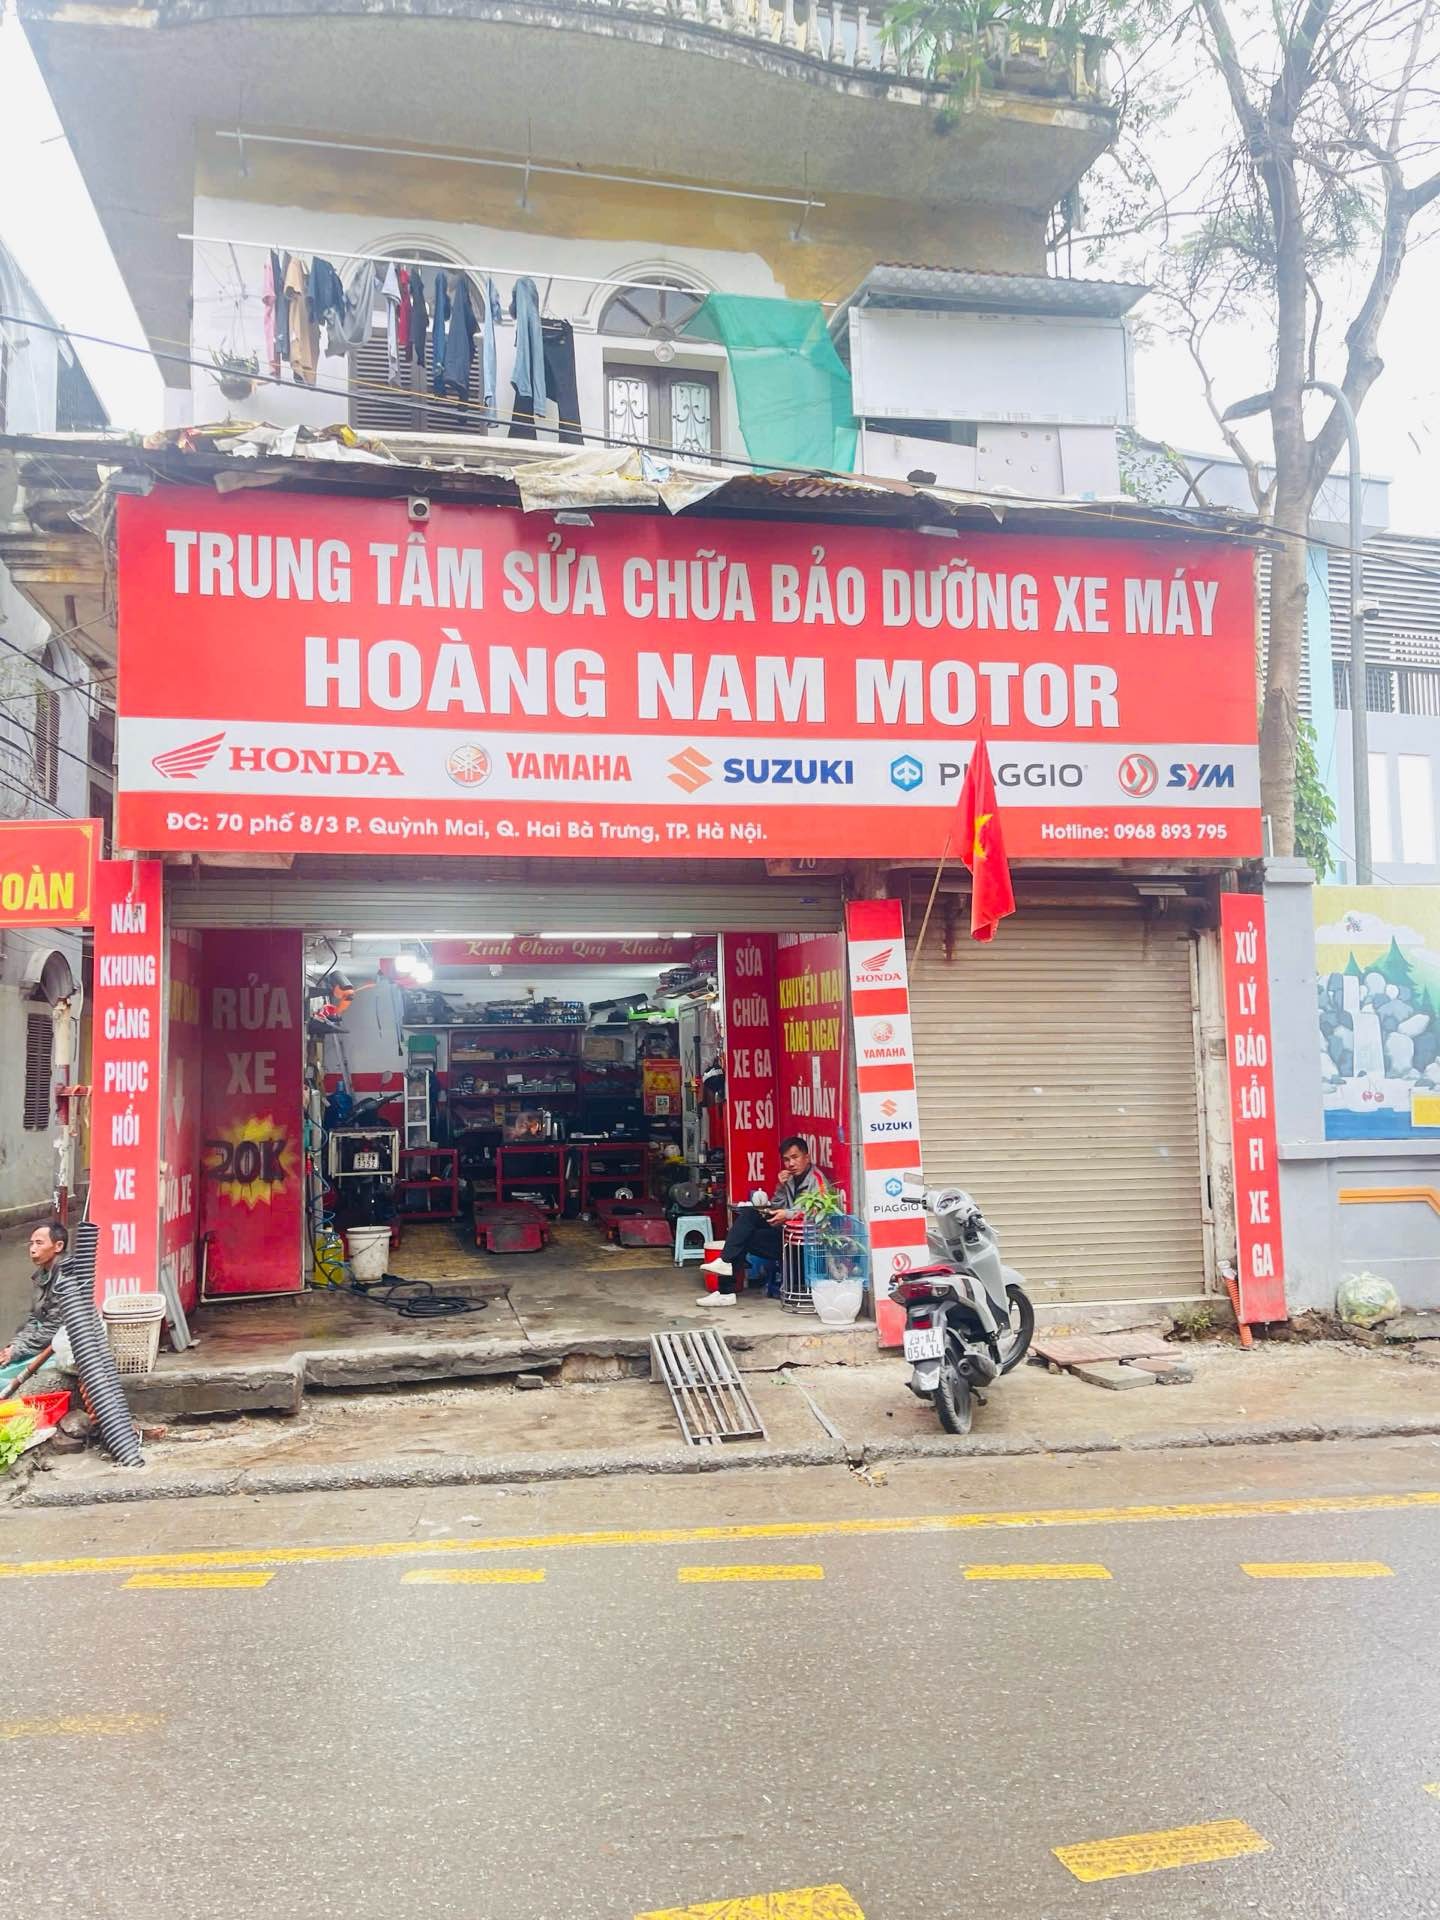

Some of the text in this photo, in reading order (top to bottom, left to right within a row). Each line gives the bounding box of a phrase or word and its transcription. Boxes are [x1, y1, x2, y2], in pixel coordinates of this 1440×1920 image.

[167, 530, 1219, 636] TRUNG TÂM SỬA CHỮA BẢO DƯỠNG XE MÁY
[305, 629, 1120, 728] HOÀNG NAM MOTOR
[229, 747, 405, 777] HONDA
[506, 752, 632, 782] YAMAHA
[723, 758, 854, 785] SUZUKI
[940, 763, 1083, 787] PIGGIO
[1166, 763, 1235, 790] SYM
[167, 812, 767, 844] ĐC: 70 phố 8/3 P. Quỳnh Mai, Q. Hai Bà Trưng, TP. Hà Nội.
[1042, 824, 1227, 840] Hotline: 0968 893 795
[0, 864, 74, 911] OÀN
[736, 937, 762, 977] SỬA
[1235, 921, 1258, 964] XỬ
[100, 955, 155, 987] KHUNG
[780, 964, 818, 1009] KHUYẾN
[856, 972, 902, 983] HONDA
[212, 972, 293, 1030] RỬA
[732, 996, 769, 1028] CHỮA
[1239, 976, 1257, 1015] LÝ
[104, 1002, 150, 1039] CÀNG
[784, 1016, 840, 1059] TẶNG NGAY
[864, 1047, 906, 1059] YAMAHA
[1235, 1027, 1266, 1067] BÁO
[226, 1051, 276, 1094] XE
[733, 1048, 772, 1078] XE GA
[104, 1061, 148, 1099] PHỤC
[1241, 1074, 1266, 1119] LỖI
[735, 1090, 774, 1130] XE SỐ
[870, 1121, 912, 1132] SUZUKI
[206, 1140, 288, 1184] 20K
[747, 1151, 765, 1181] XE
[819, 1136, 833, 1168] XE
[1249, 1138, 1264, 1171] FI
[114, 1168, 136, 1200] XE
[874, 1203, 919, 1213] PIAGGIO
[1249, 1190, 1270, 1224] XE
[112, 1223, 135, 1254] TAI
[1252, 1243, 1274, 1278] GA
